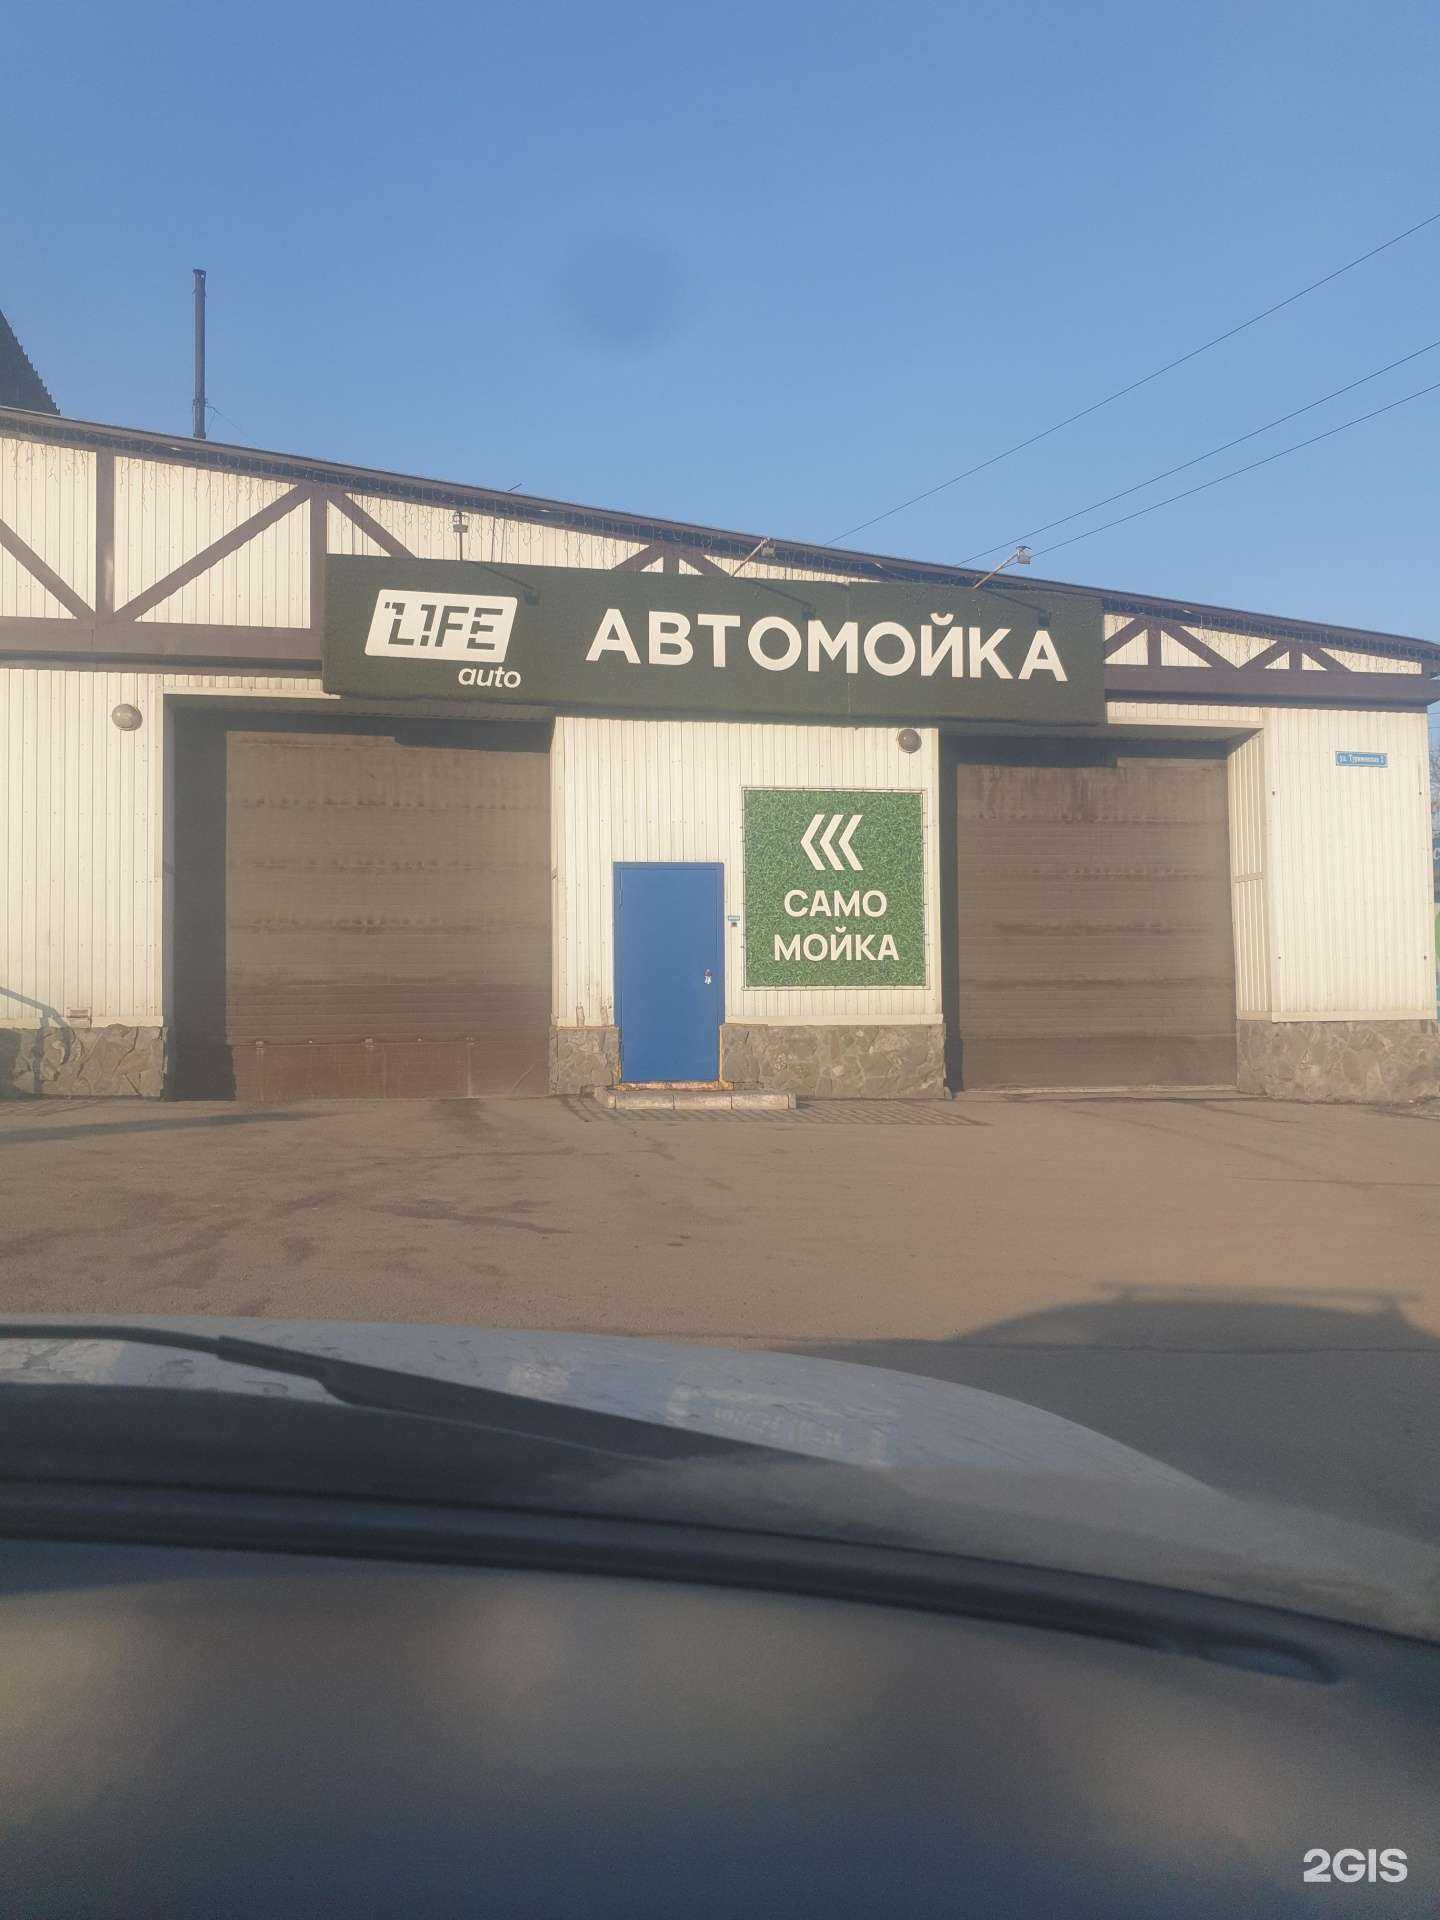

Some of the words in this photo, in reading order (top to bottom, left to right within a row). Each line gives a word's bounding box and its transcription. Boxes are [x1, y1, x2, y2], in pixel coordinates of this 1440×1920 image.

[585, 608, 1069, 682] АВТОМОЙКА
[458, 666, 521, 688] auto
[784, 889, 888, 918] САМО
[774, 926, 900, 962] МОЙКА
